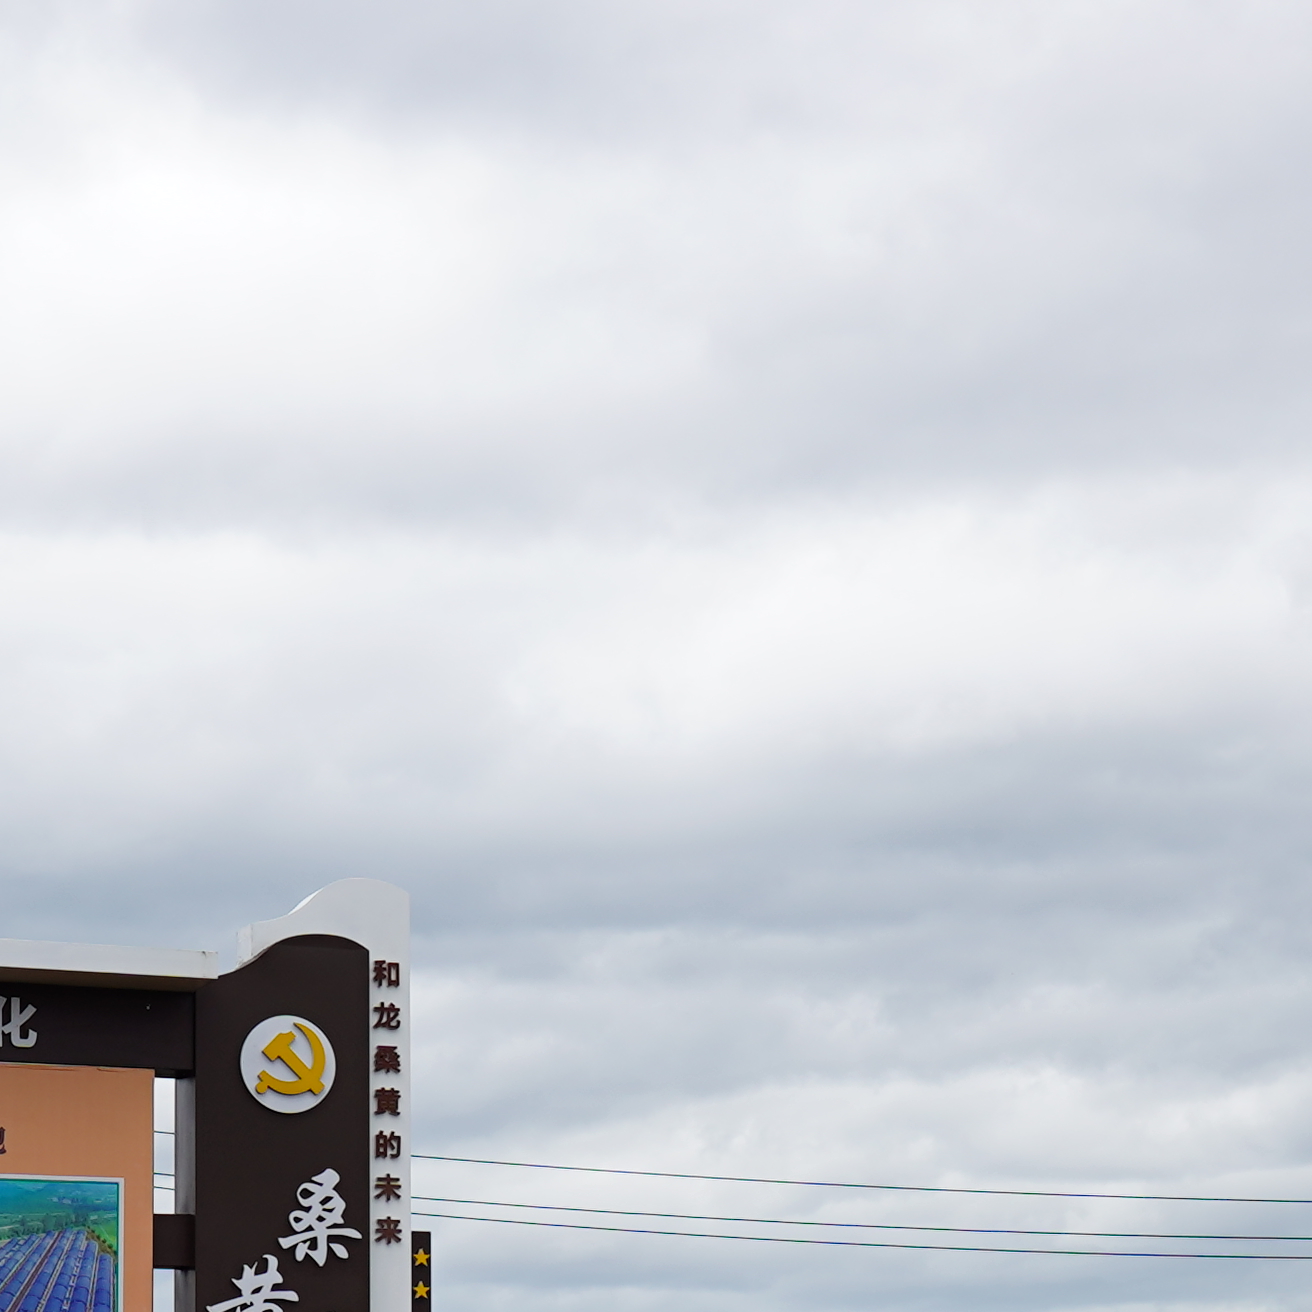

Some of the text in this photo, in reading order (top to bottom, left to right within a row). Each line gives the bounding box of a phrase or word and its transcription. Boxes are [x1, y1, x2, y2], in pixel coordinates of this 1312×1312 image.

[372, 960, 403, 1246] 和龙桑黄的未来
